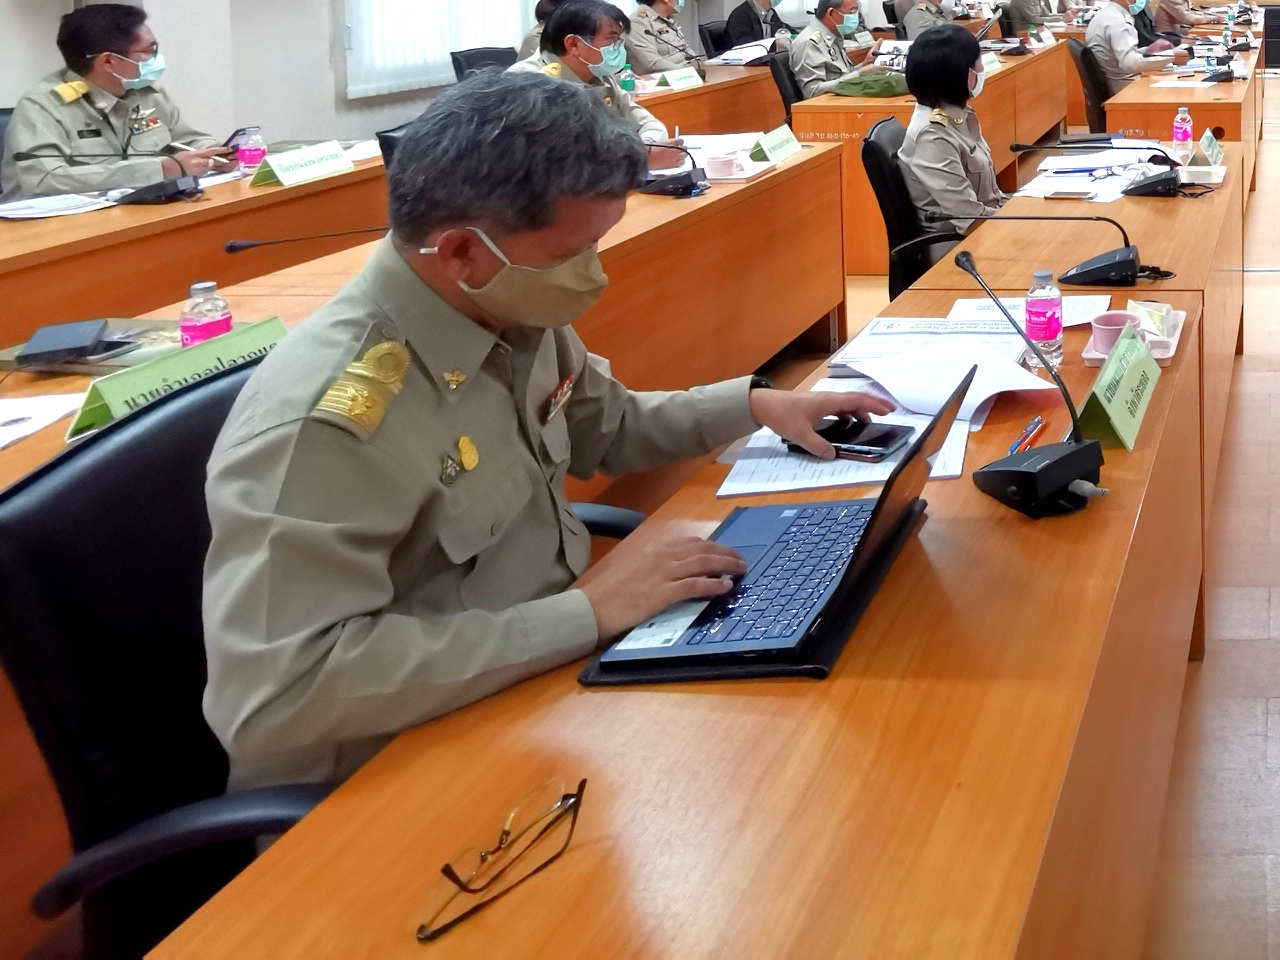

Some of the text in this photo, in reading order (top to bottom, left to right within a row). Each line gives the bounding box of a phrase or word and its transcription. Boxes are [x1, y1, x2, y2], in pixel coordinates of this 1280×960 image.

[1125, 369, 1151, 419] จังหวัดระยอง
